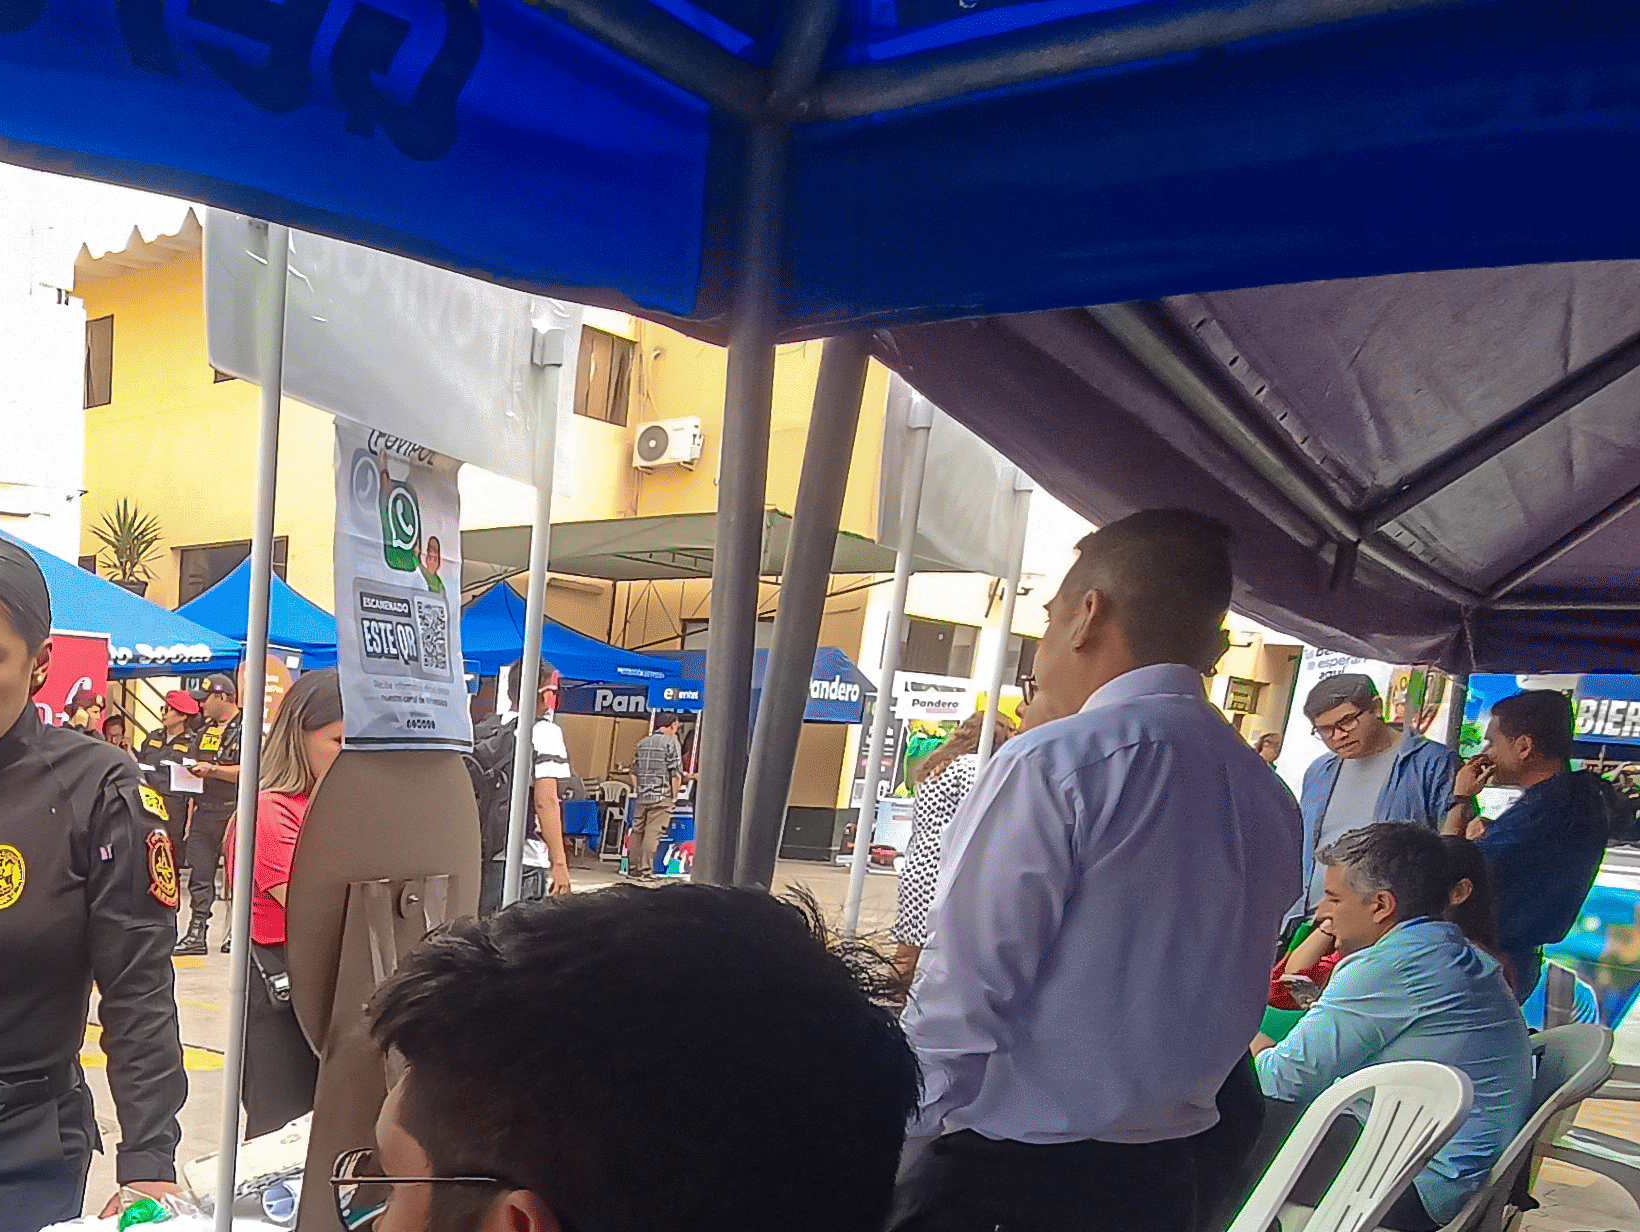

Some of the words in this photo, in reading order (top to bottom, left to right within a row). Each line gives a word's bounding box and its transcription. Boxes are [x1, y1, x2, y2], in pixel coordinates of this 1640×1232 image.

[363, 620, 398, 655] ESTE
[397, 623, 418, 662] QR
[810, 675, 860, 702] andero
[911, 698, 959, 709] Pandero
